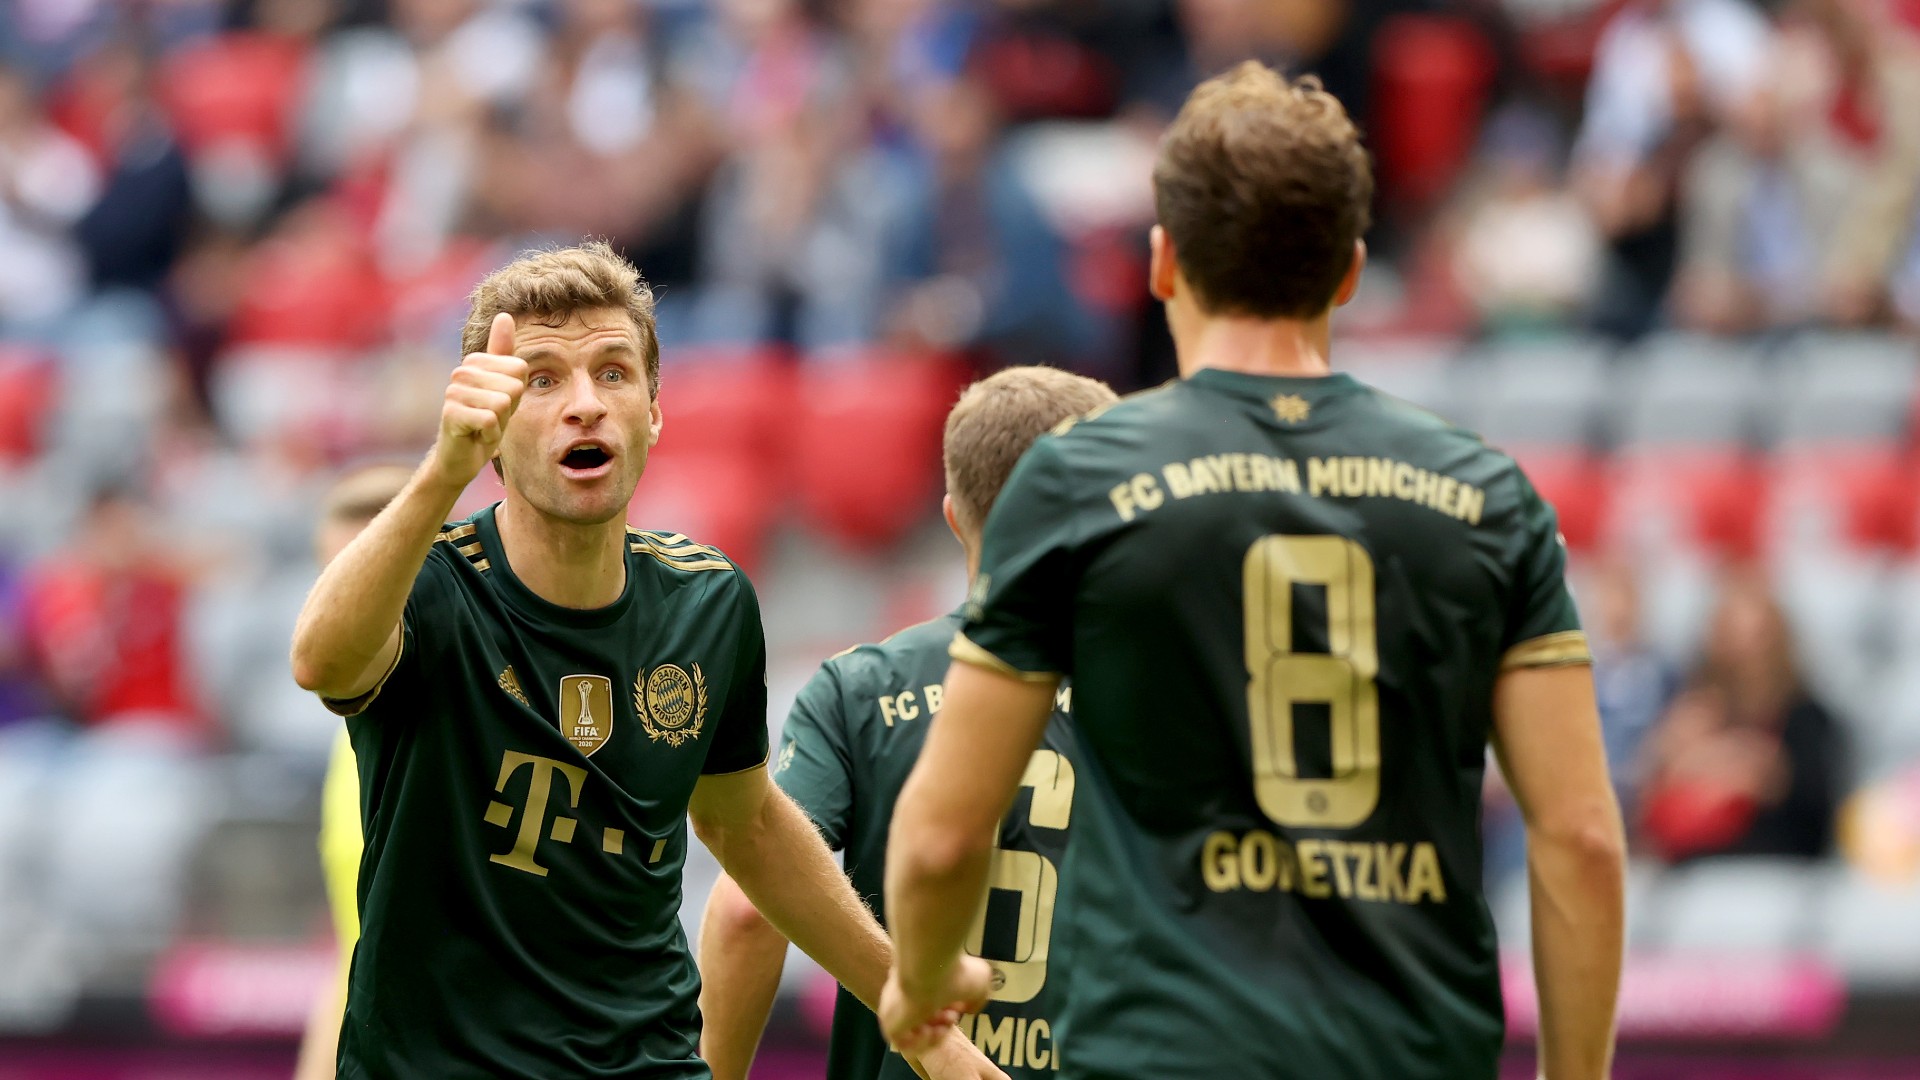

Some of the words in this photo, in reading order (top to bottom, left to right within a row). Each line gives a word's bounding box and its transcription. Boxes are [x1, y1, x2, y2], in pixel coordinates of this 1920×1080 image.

[1109, 473, 1164, 522] FC
[1163, 453, 1299, 499] BAYERN
[1307, 456, 1485, 525] MÜNCHEN
[657, 669, 689, 691] BAYERN
[1243, 534, 1380, 829] 8
[574, 726, 598, 736] FIFA
[878, 690, 919, 727] FC
[965, 749, 1075, 1003] 6
